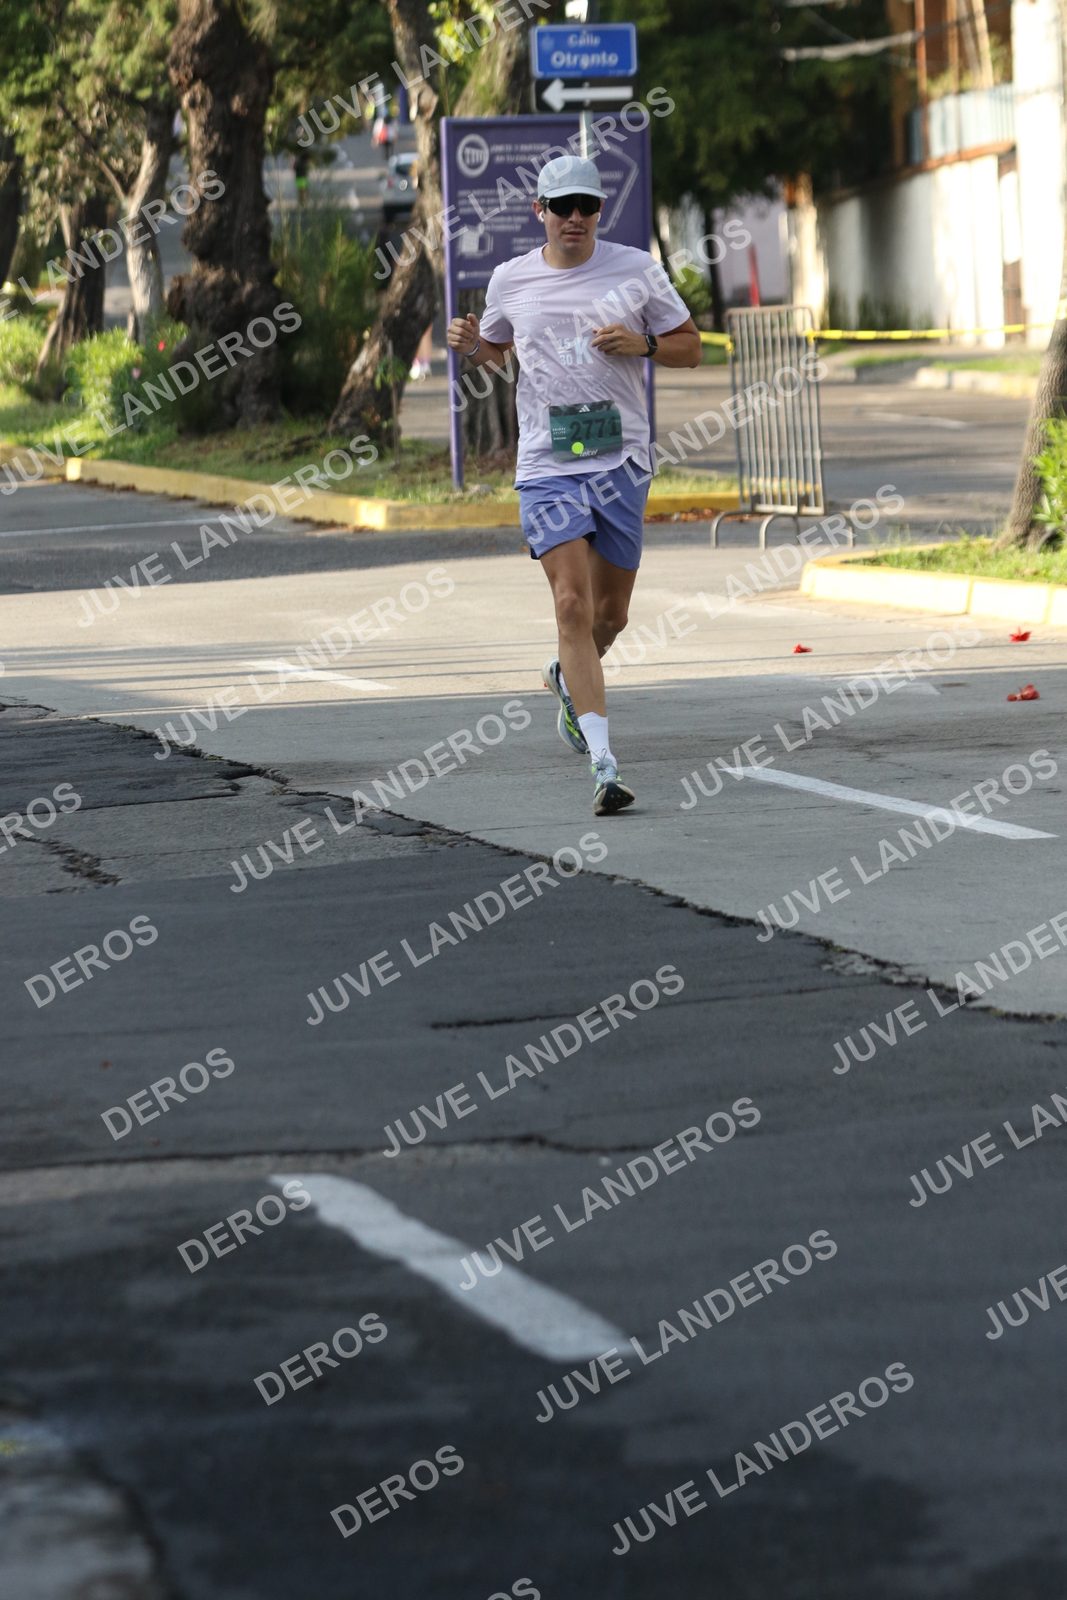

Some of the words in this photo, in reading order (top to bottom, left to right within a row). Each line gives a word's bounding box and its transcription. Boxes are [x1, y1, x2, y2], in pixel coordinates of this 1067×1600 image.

[550, 50, 619, 69] Otranto
[560, 354, 573, 366] 30
[575, 336, 594, 365] K
